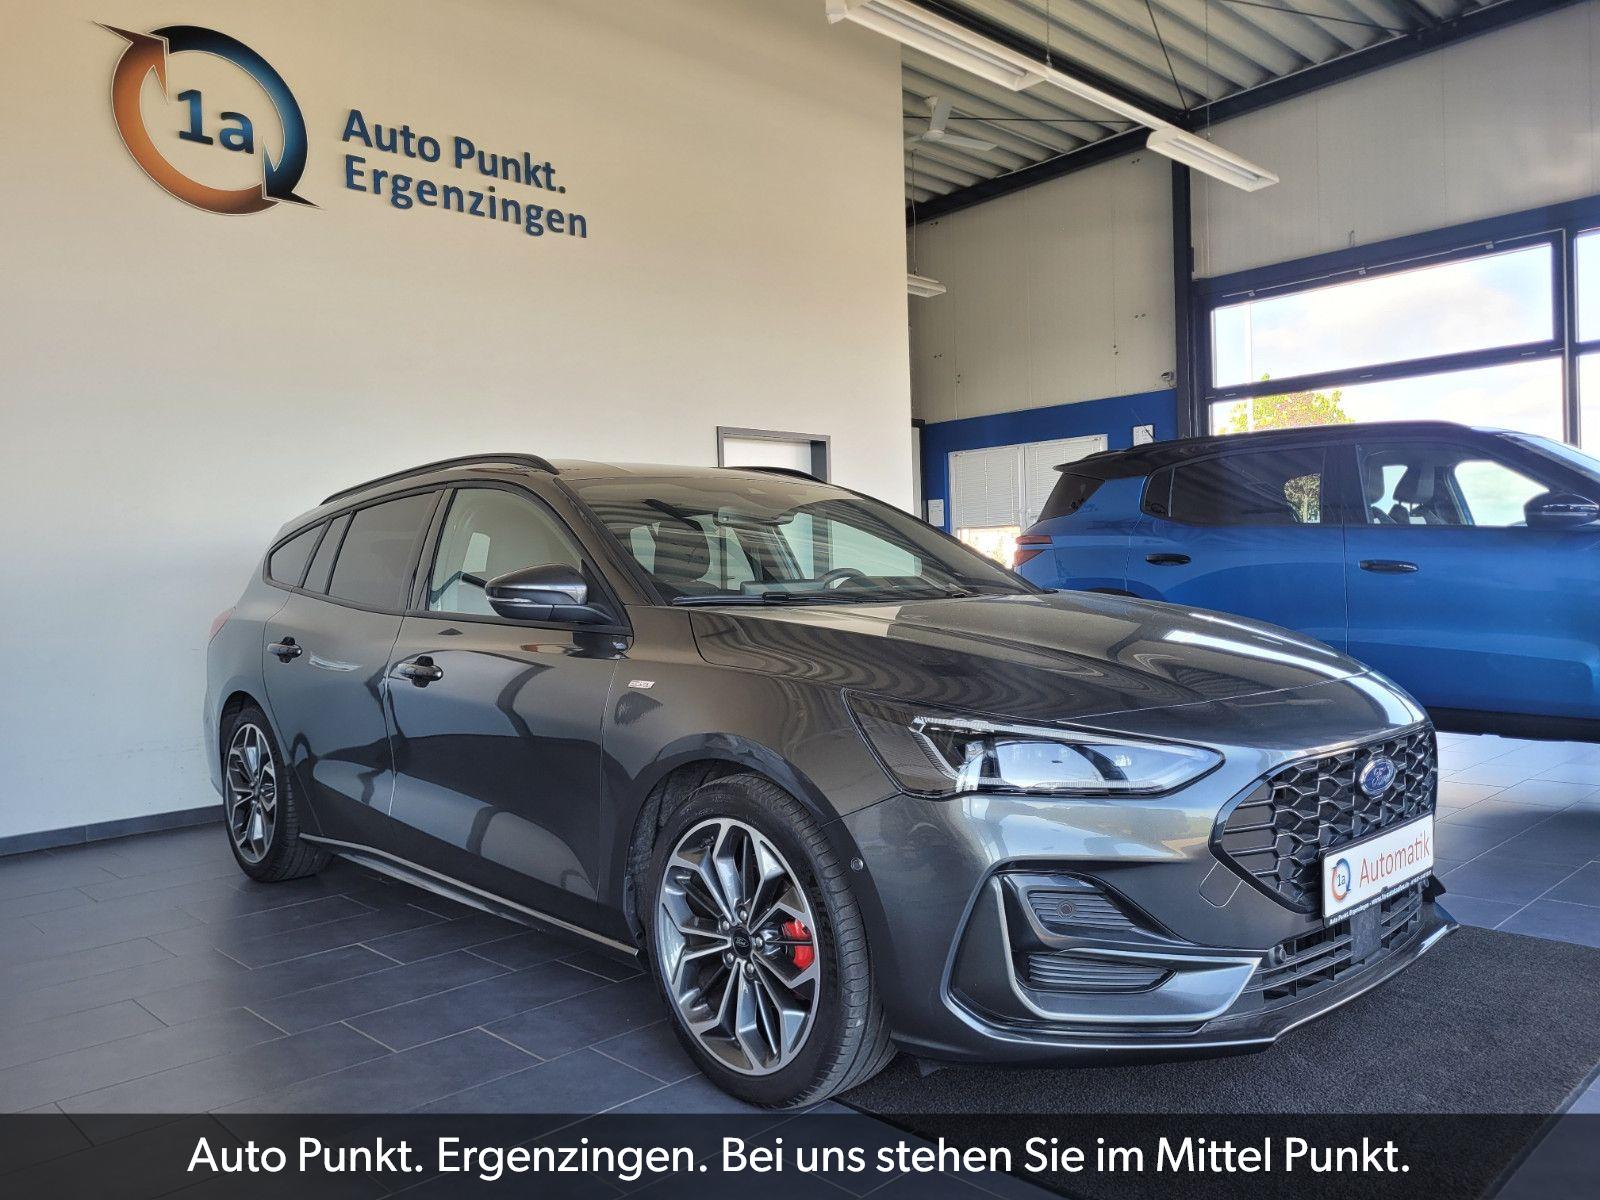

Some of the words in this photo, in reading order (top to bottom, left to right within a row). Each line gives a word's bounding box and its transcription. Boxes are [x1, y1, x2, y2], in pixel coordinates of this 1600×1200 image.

[176, 88, 255, 155] 1a
[341, 108, 441, 163] Auto
[453, 135, 567, 194] Punkt.
[345, 153, 588, 239] Ergenzingen
[1336, 873, 1346, 887] 1a
[1359, 830, 1430, 888] Automatik
